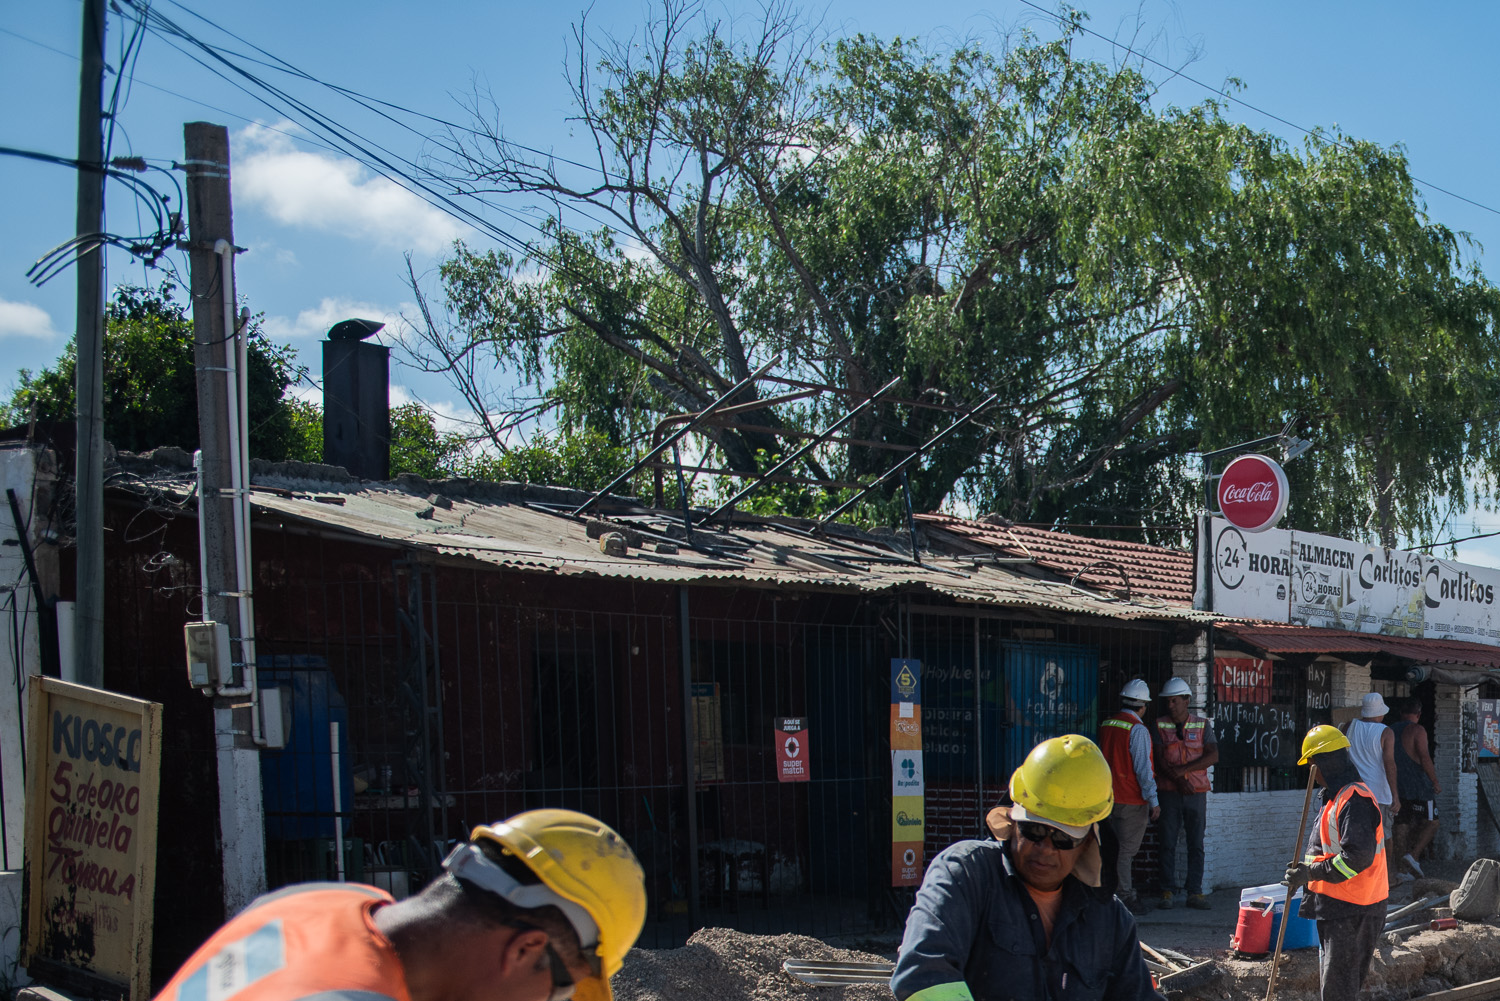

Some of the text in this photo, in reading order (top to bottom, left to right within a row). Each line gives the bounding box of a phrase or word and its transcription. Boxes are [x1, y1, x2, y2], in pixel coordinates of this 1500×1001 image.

[1223, 481, 1275, 505] Coca-Cola
[1224, 546, 1240, 569] 24
[1299, 543, 1355, 571] ALMACEN
[1358, 553, 1420, 590] Carlitos
[1305, 581, 1342, 597] 24 HORAS
[1424, 564, 1495, 609] Carlitos
[900, 673, 911, 686] 5
[1222, 665, 1259, 689] Claro
[52, 709, 143, 774] KIOSCO
[782, 766, 804, 775] match
[783, 760, 803, 768] super
[49, 804, 133, 855] Quiniela
